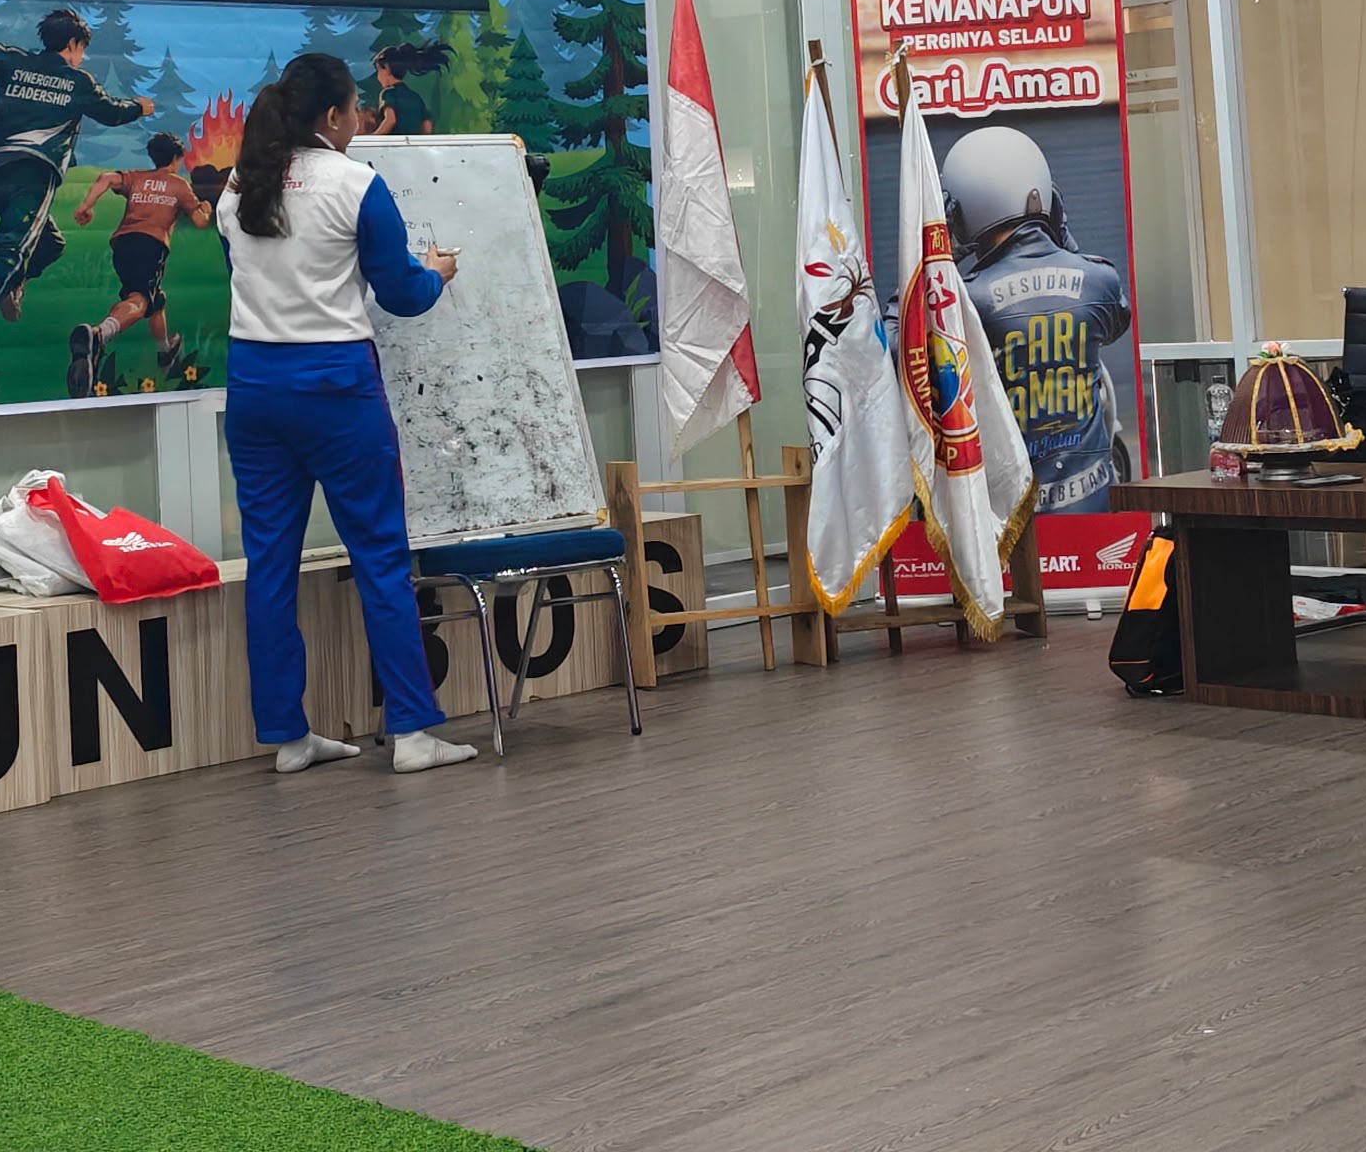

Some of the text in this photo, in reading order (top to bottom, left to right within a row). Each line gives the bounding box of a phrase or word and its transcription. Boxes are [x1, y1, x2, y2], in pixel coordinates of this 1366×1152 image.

[903, 25, 1072, 51] PERGINYA SELALU
[12, 69, 75, 93] SYNERGIZING
[5, 84, 72, 107] LEADERSHIP
[143, 179, 167, 192] FUN
[131, 193, 177, 207] FELLOWSHIP
[994, 273, 1083, 304] SESUDAH
[1007, 366, 1095, 433] AMAN
[894, 562, 945, 573] AHM
[1040, 556, 1081, 573] EART.
